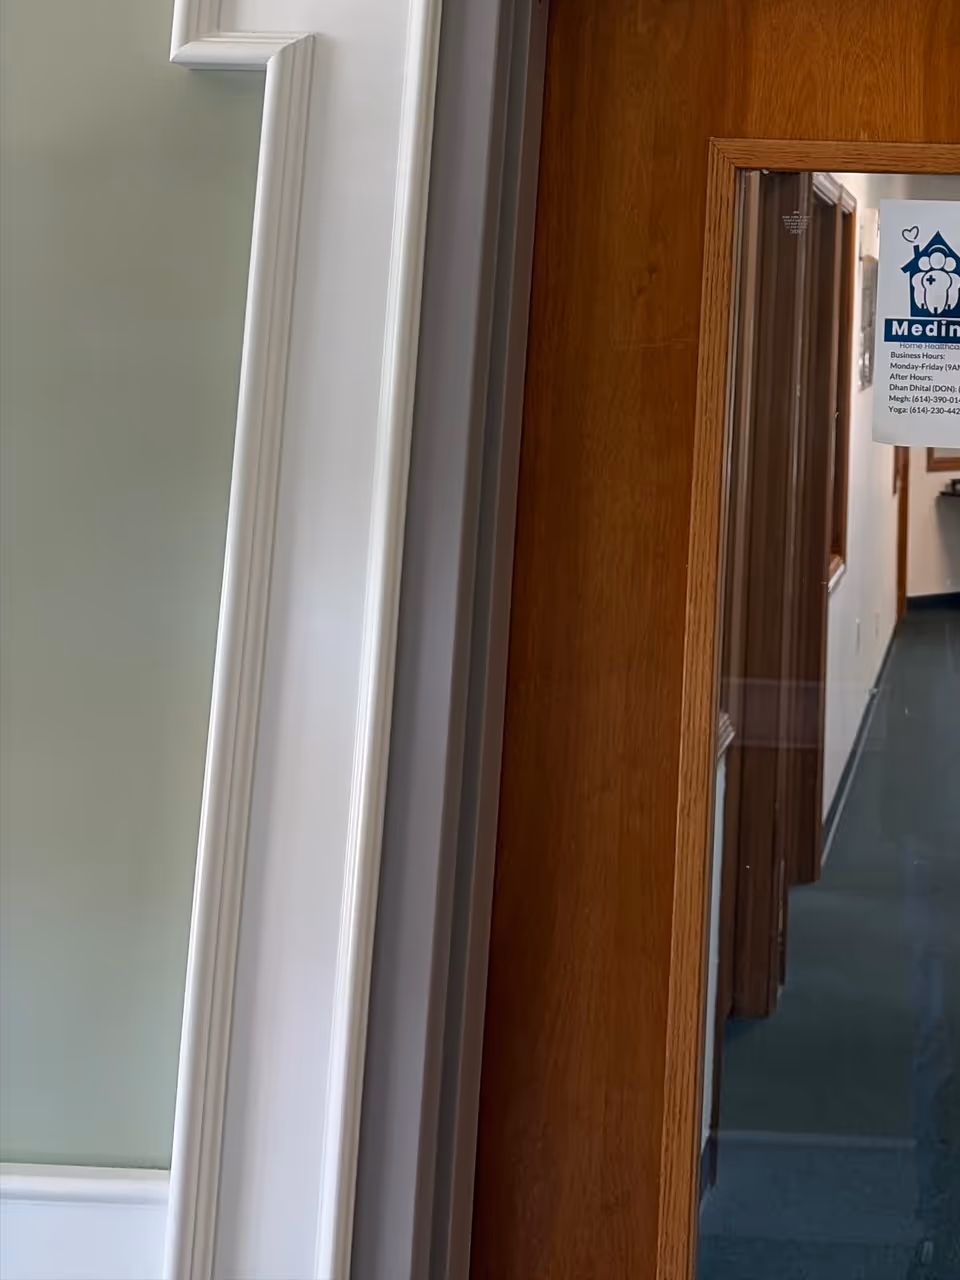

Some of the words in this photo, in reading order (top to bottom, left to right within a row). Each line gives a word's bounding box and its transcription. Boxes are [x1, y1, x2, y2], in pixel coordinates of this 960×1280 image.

[899, 342, 923, 350] Home
[890, 351, 921, 359] Business
[922, 352, 945, 360] Hours:
[890, 362, 943, 372] Monday-Friday
[889, 373, 908, 381] After
[909, 373, 933, 381] Hours:
[889, 383, 908, 392] Dhan
[909, 384, 931, 392] Dhital
[932, 384, 957, 393] (DON):
[888, 395, 911, 403] Megh:
[888, 405, 908, 414] Yoga:
